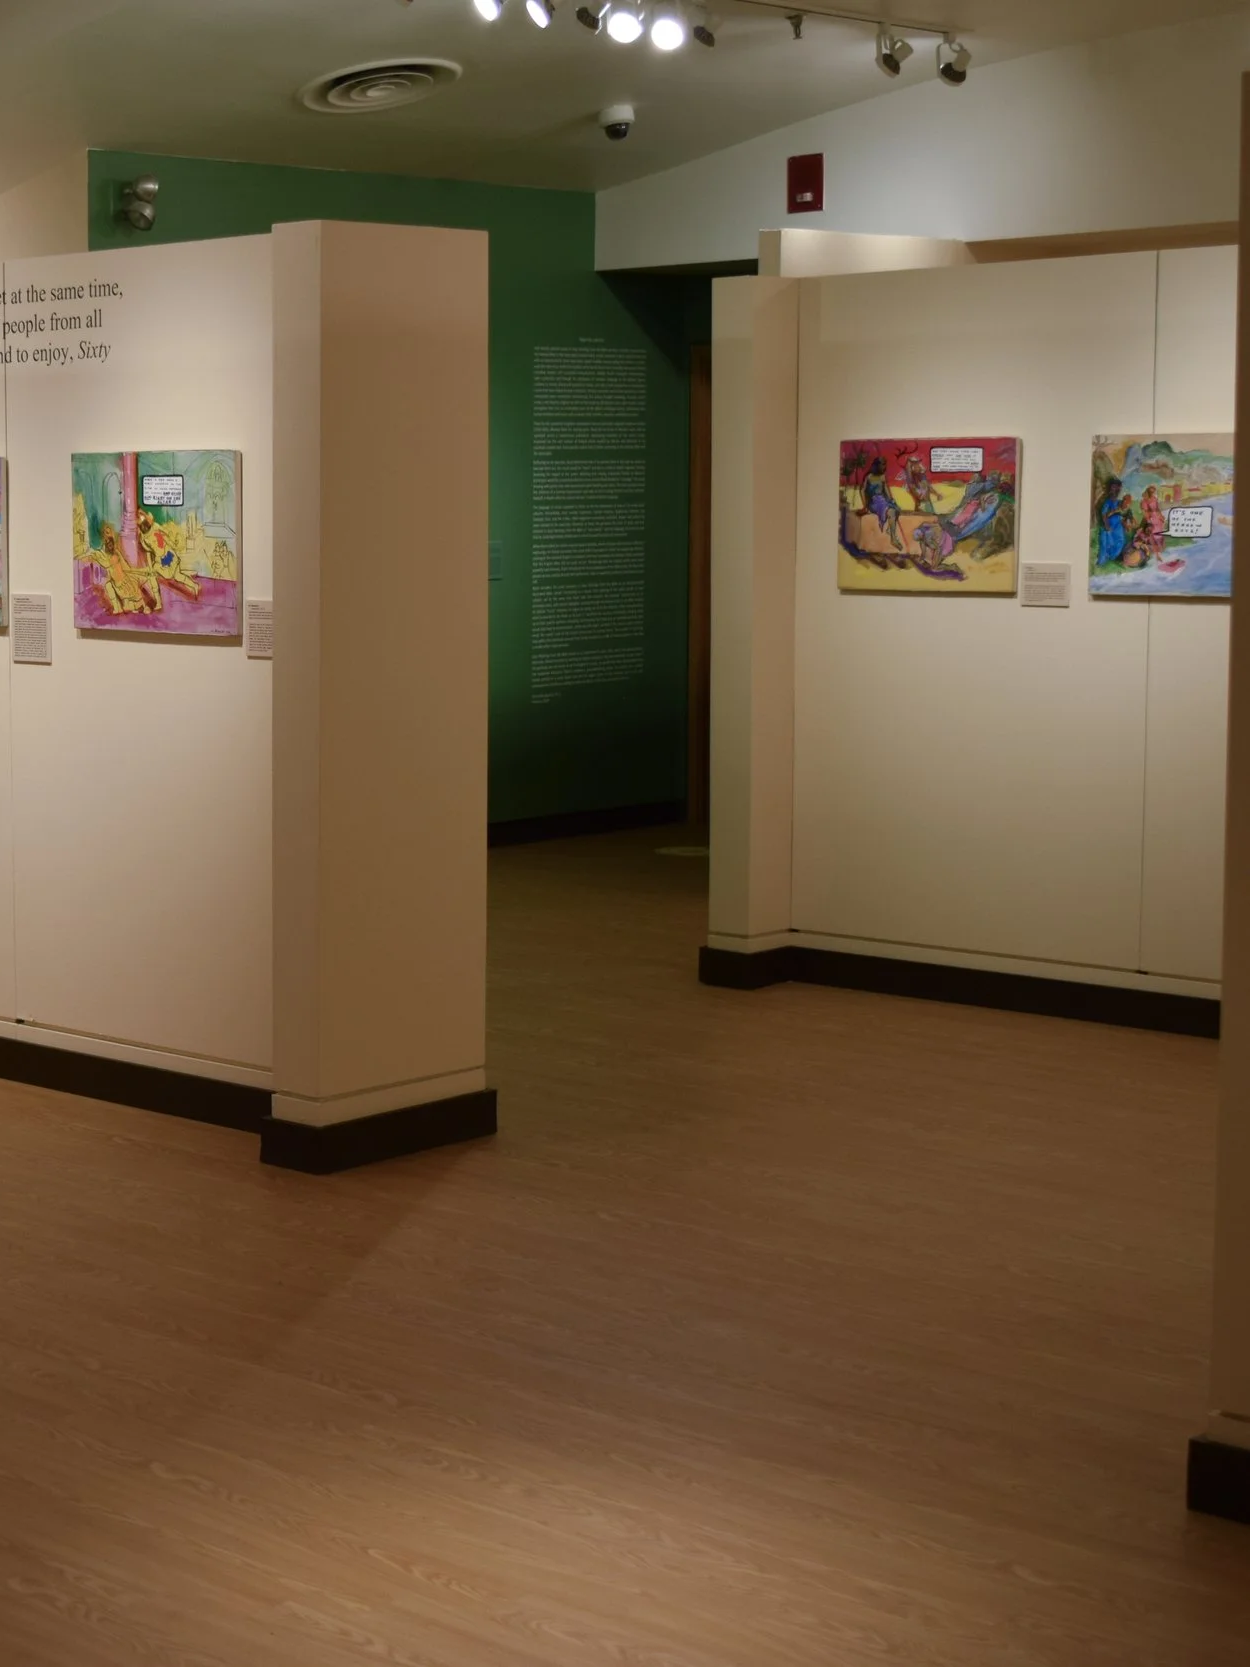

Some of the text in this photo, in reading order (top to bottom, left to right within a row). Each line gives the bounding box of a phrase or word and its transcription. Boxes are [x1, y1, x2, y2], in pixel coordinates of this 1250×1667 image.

[10, 287, 23, 305] at
[26, 284, 47, 304] the
[50, 284, 85, 302] same
[88, 278, 123, 300] time,
[2, 313, 46, 340] people
[50, 311, 82, 332] from
[85, 308, 103, 329] all
[16, 347, 29, 363] to
[32, 342, 74, 367] enjoy,
[77, 340, 112, 364] Sixty
